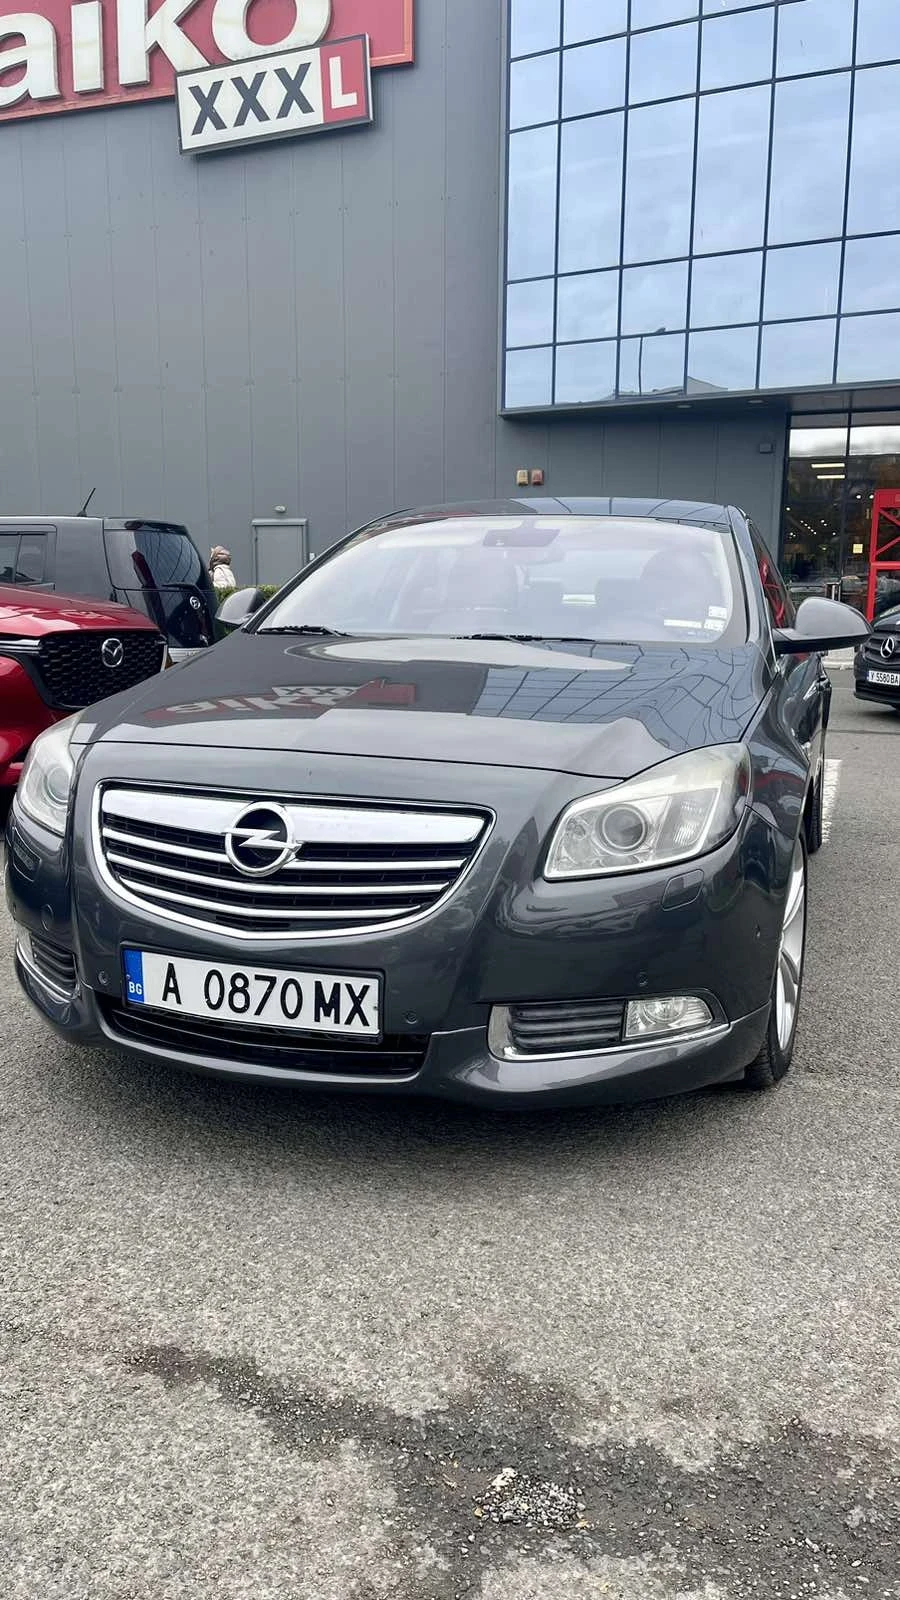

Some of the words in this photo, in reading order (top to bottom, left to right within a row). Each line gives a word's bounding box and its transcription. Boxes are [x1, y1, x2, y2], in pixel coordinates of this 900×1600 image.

[128, 981, 143, 995] BG
[161, 962, 182, 1005] A
[204, 969, 303, 1020] 0870
[314, 980, 370, 1027] MX
